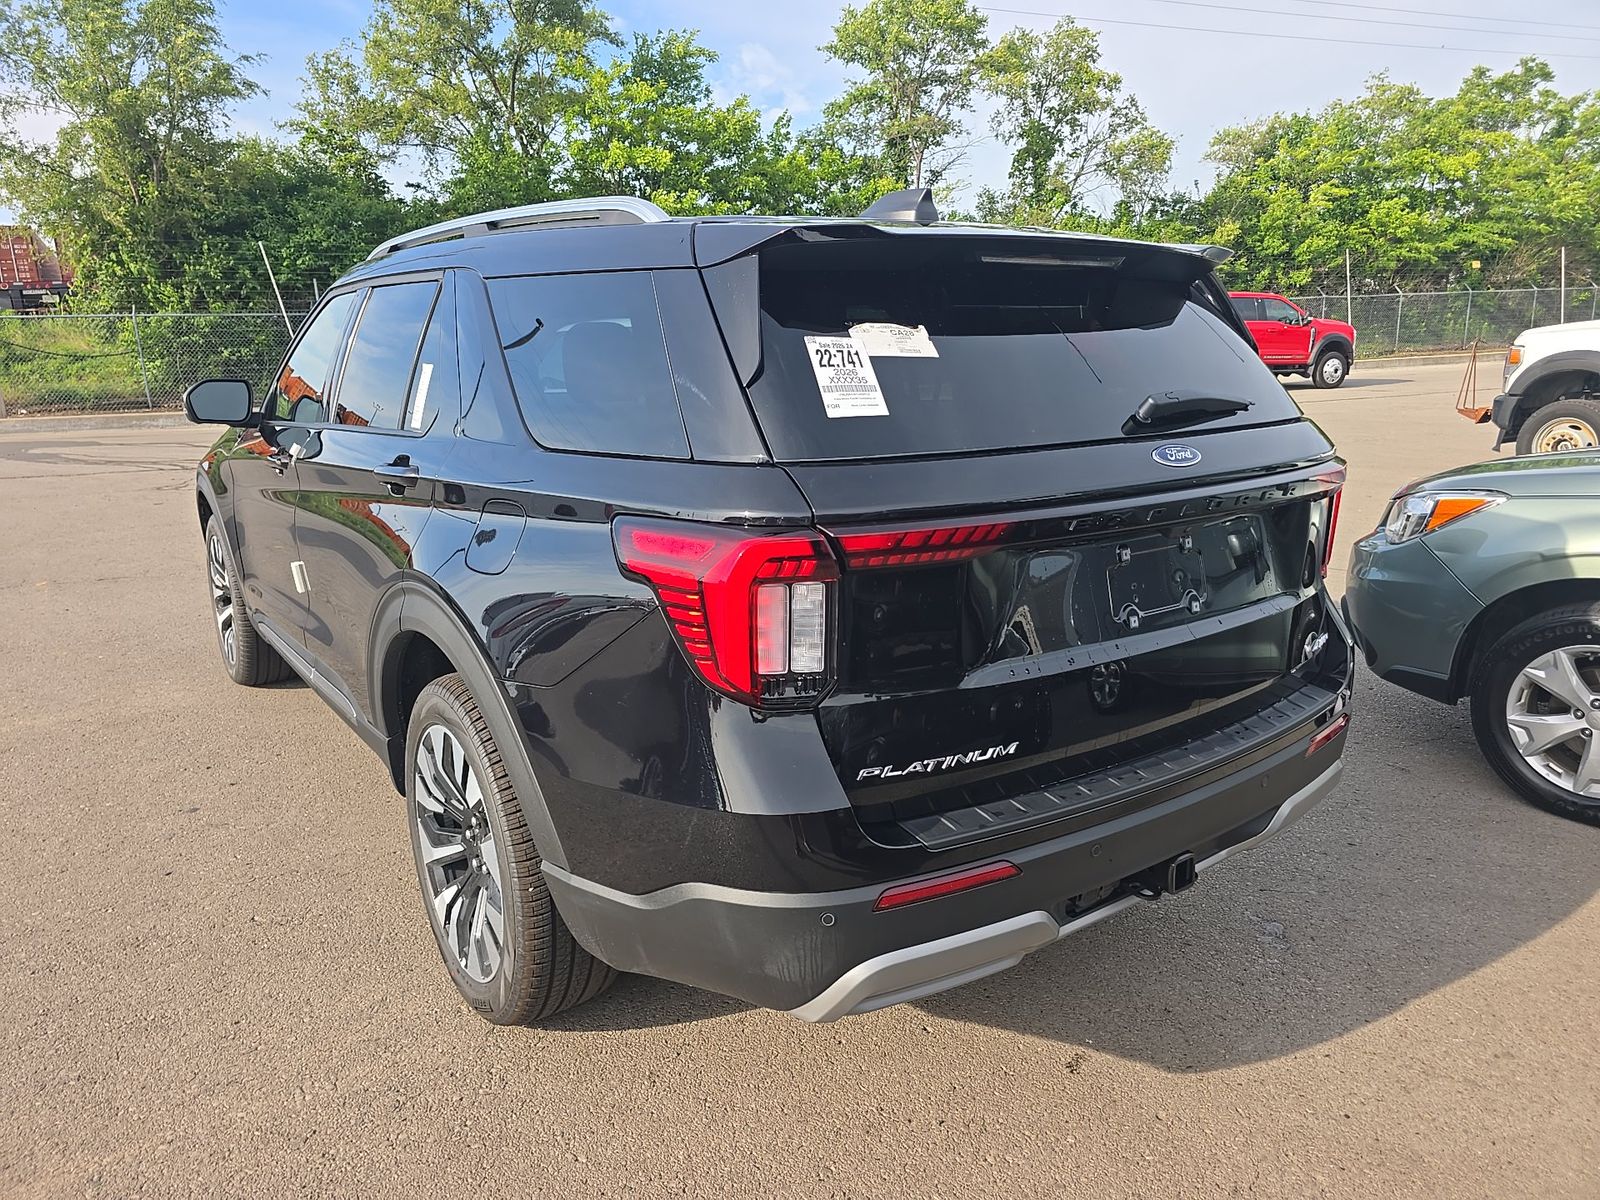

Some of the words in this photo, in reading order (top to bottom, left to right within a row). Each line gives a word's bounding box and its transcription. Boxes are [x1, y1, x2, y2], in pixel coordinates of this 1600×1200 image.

[828, 376, 868, 384] XXXX35
[1165, 447, 1194, 461] Ford
[856, 741, 1020, 781] PLATINUM
